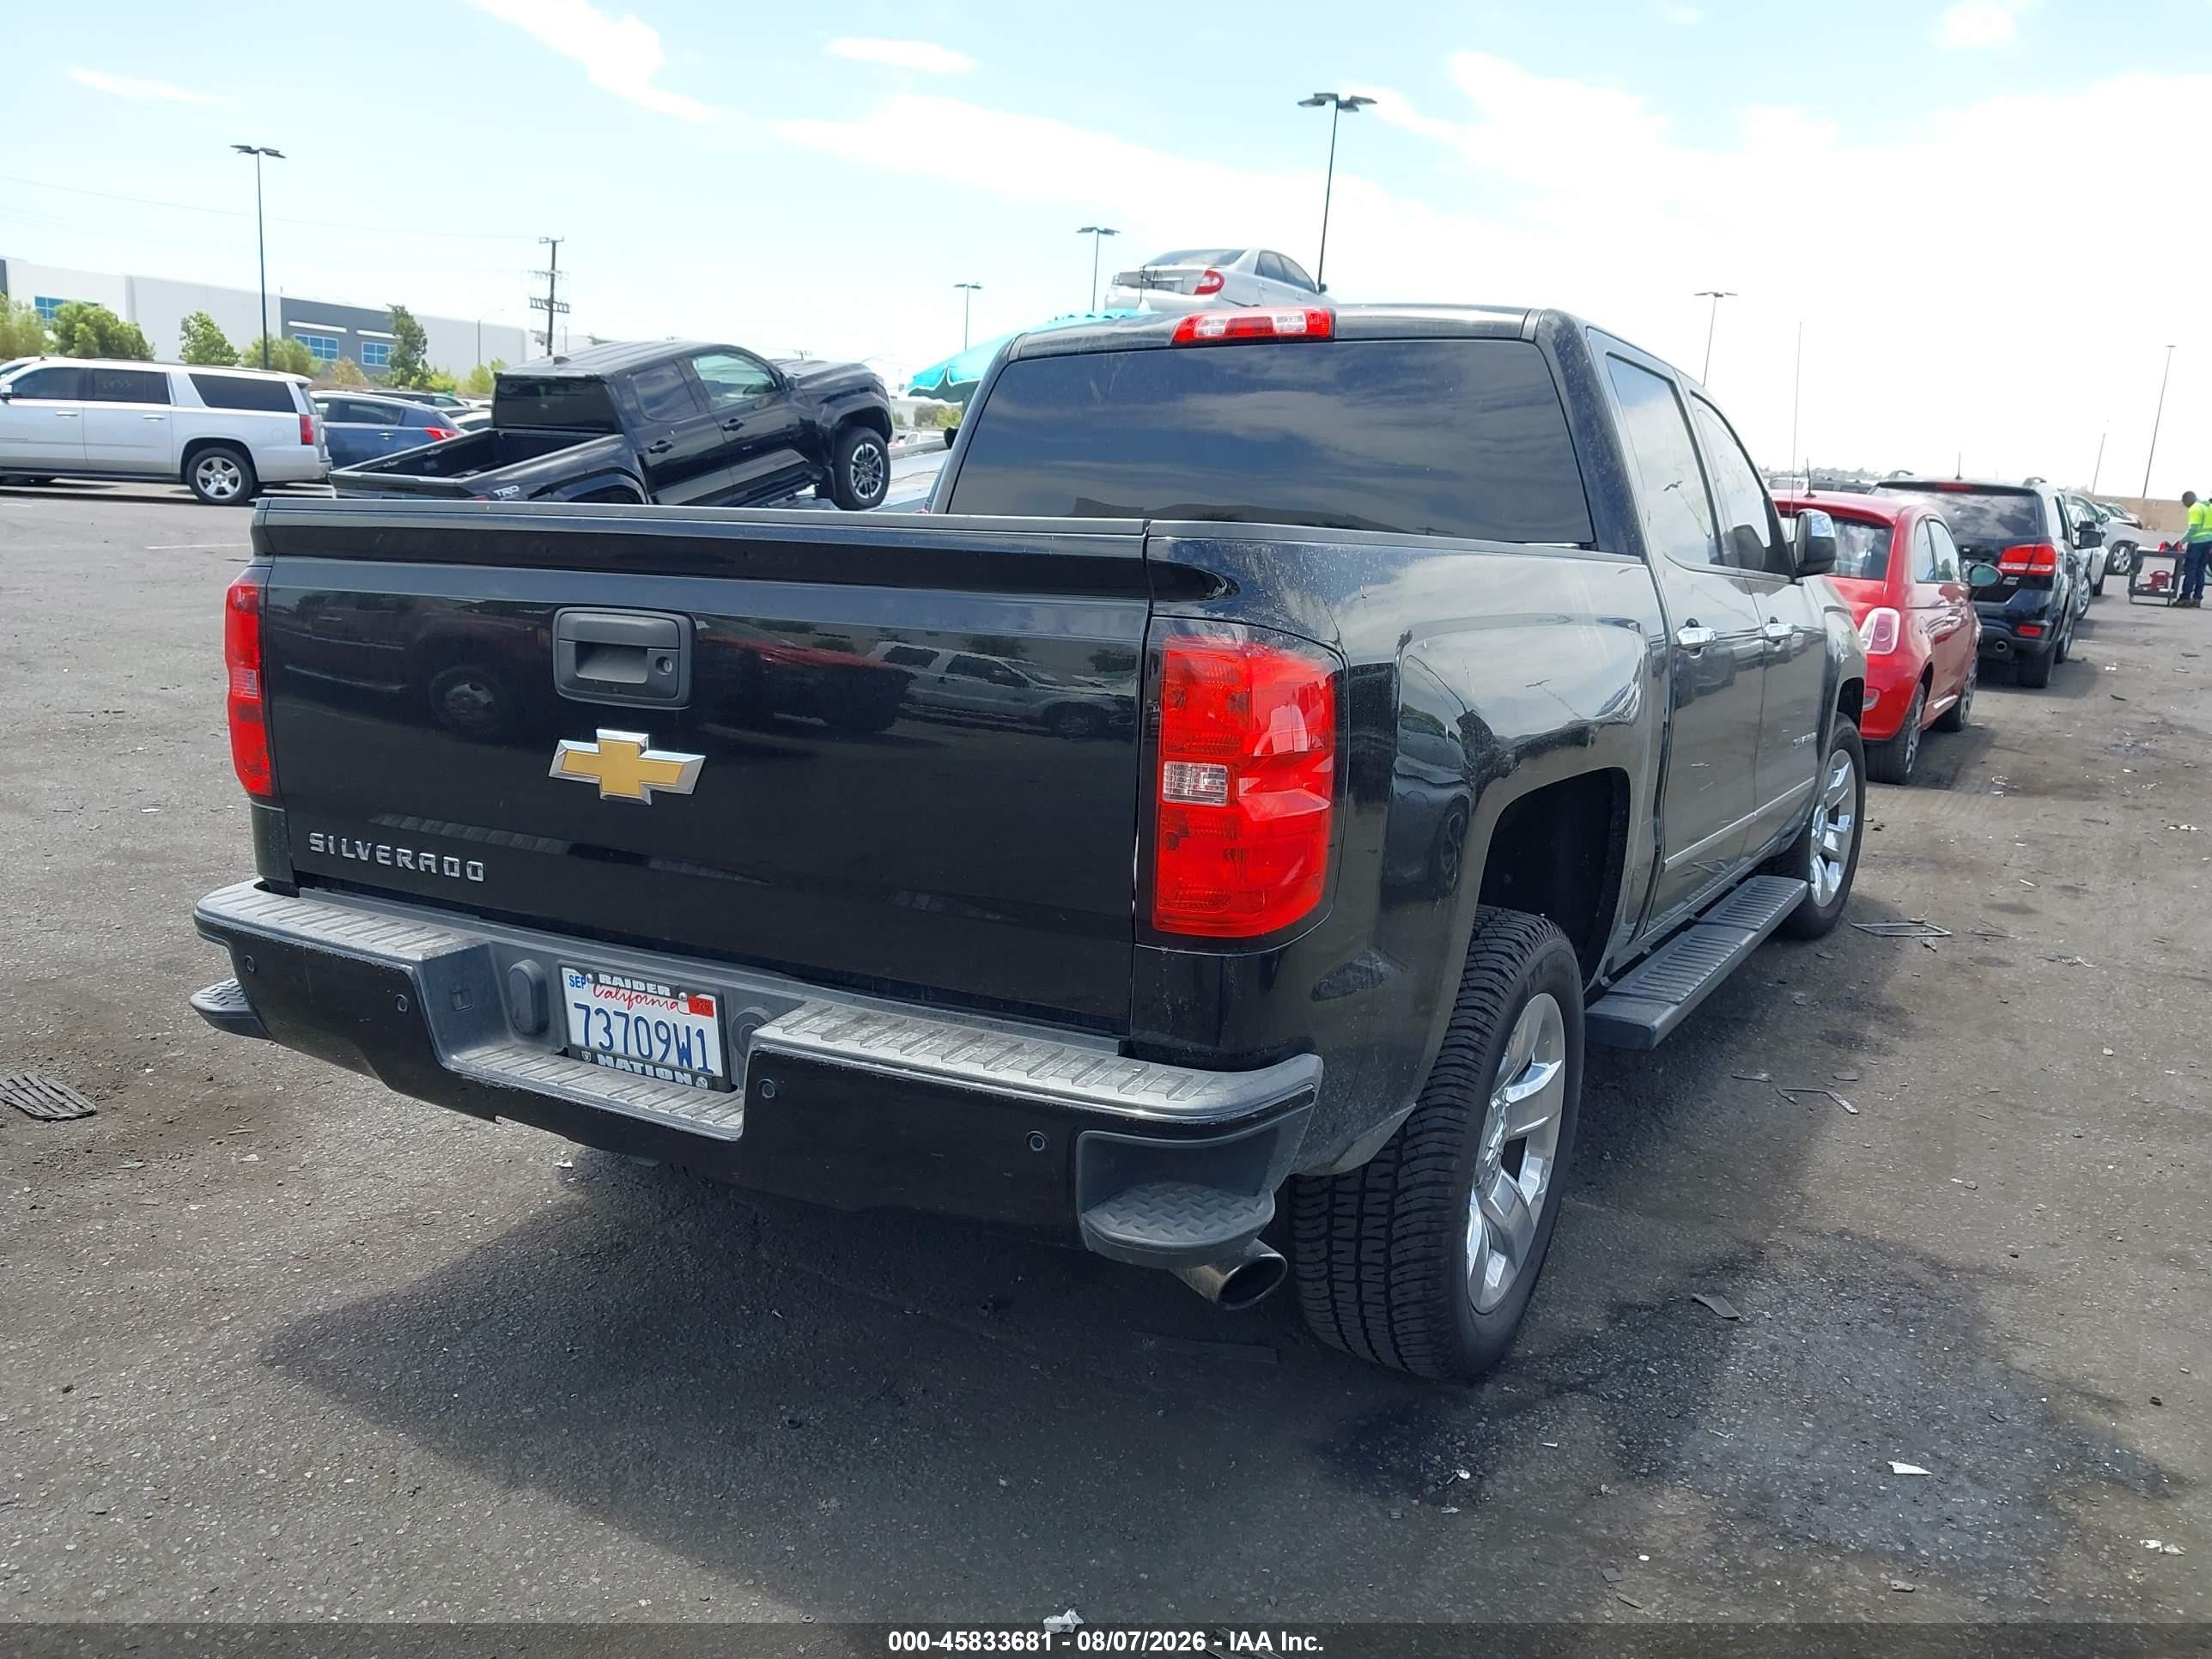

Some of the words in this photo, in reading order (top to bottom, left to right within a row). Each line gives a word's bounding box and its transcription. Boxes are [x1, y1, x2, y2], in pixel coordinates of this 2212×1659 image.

[494, 485, 520, 497] TRD
[309, 832, 484, 882] SILVERADO
[568, 975, 586, 989] SEP
[599, 973, 671, 997] RAIDER
[592, 983, 690, 1015] California
[574, 1002, 714, 1074] 73709W1
[596, 1054, 694, 1086] NATION
